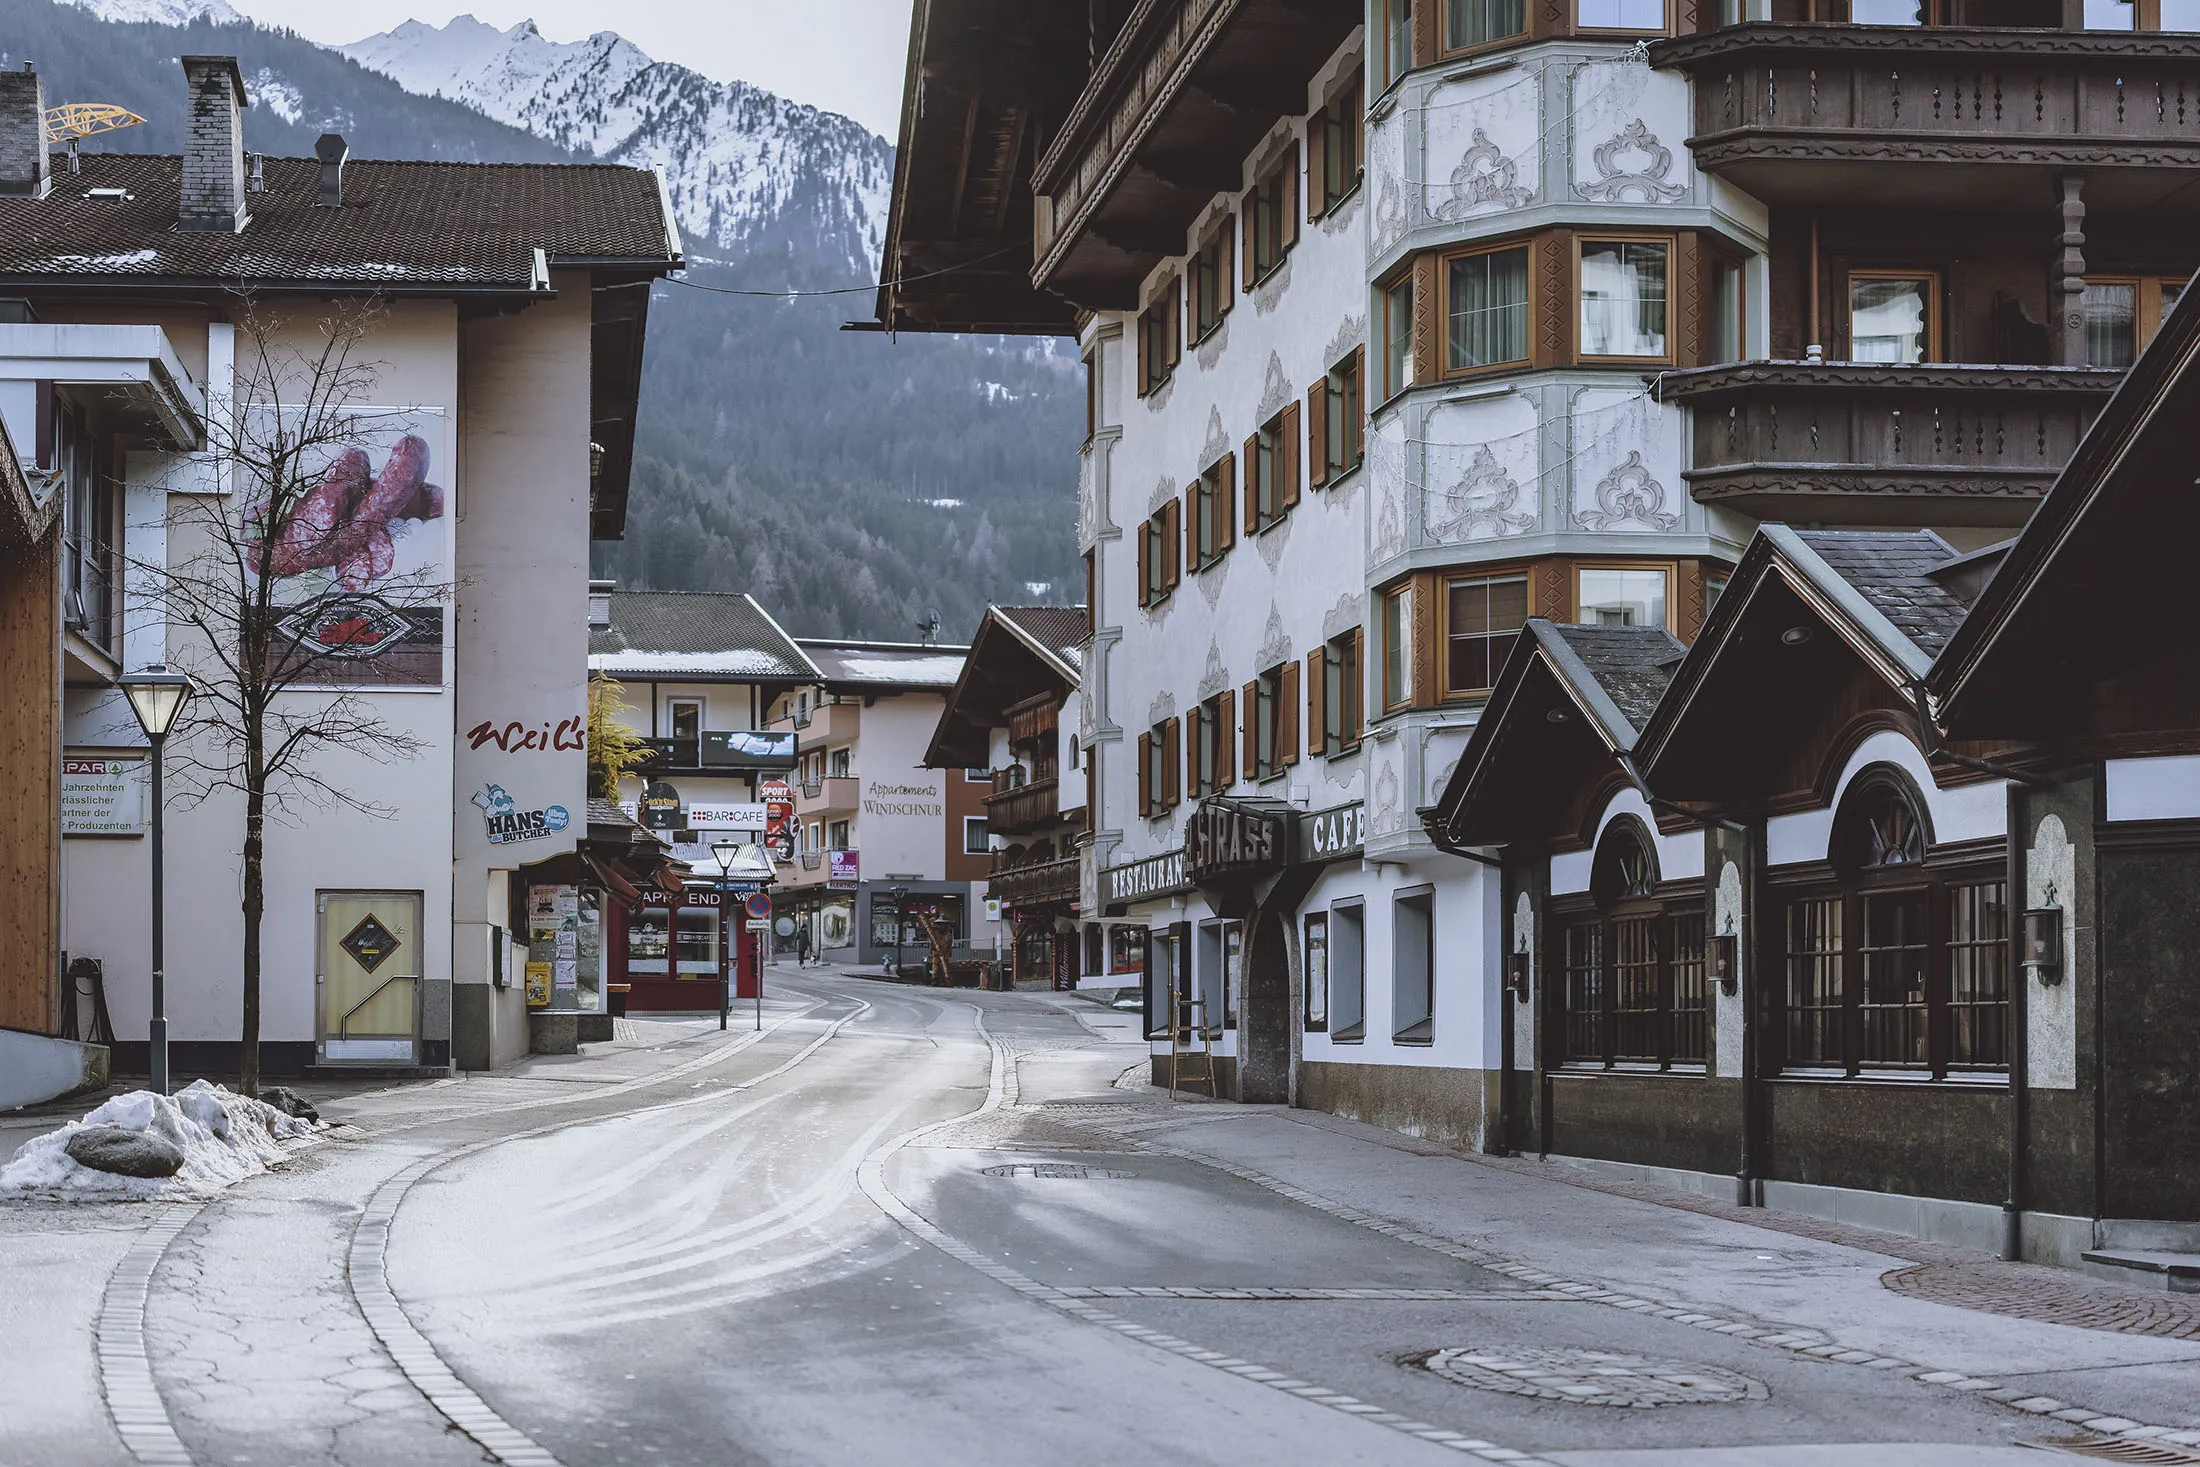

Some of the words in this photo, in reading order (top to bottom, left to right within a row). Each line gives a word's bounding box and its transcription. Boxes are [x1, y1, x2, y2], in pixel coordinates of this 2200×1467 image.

[63, 762, 105, 773] PAR
[62, 783, 124, 792] Jahrzehnten
[761, 786, 789, 796] SPORT
[869, 781, 937, 799] Appartements
[94, 807, 111, 817] der
[863, 800, 942, 817] WINDSCHNUR
[706, 811, 728, 822] BAR
[733, 809, 763, 823] CAFÉ
[68, 821, 132, 830] Produzenten
[487, 810, 546, 836] HANS
[502, 828, 552, 843] BUTCHER
[688, 893, 721, 905] END
